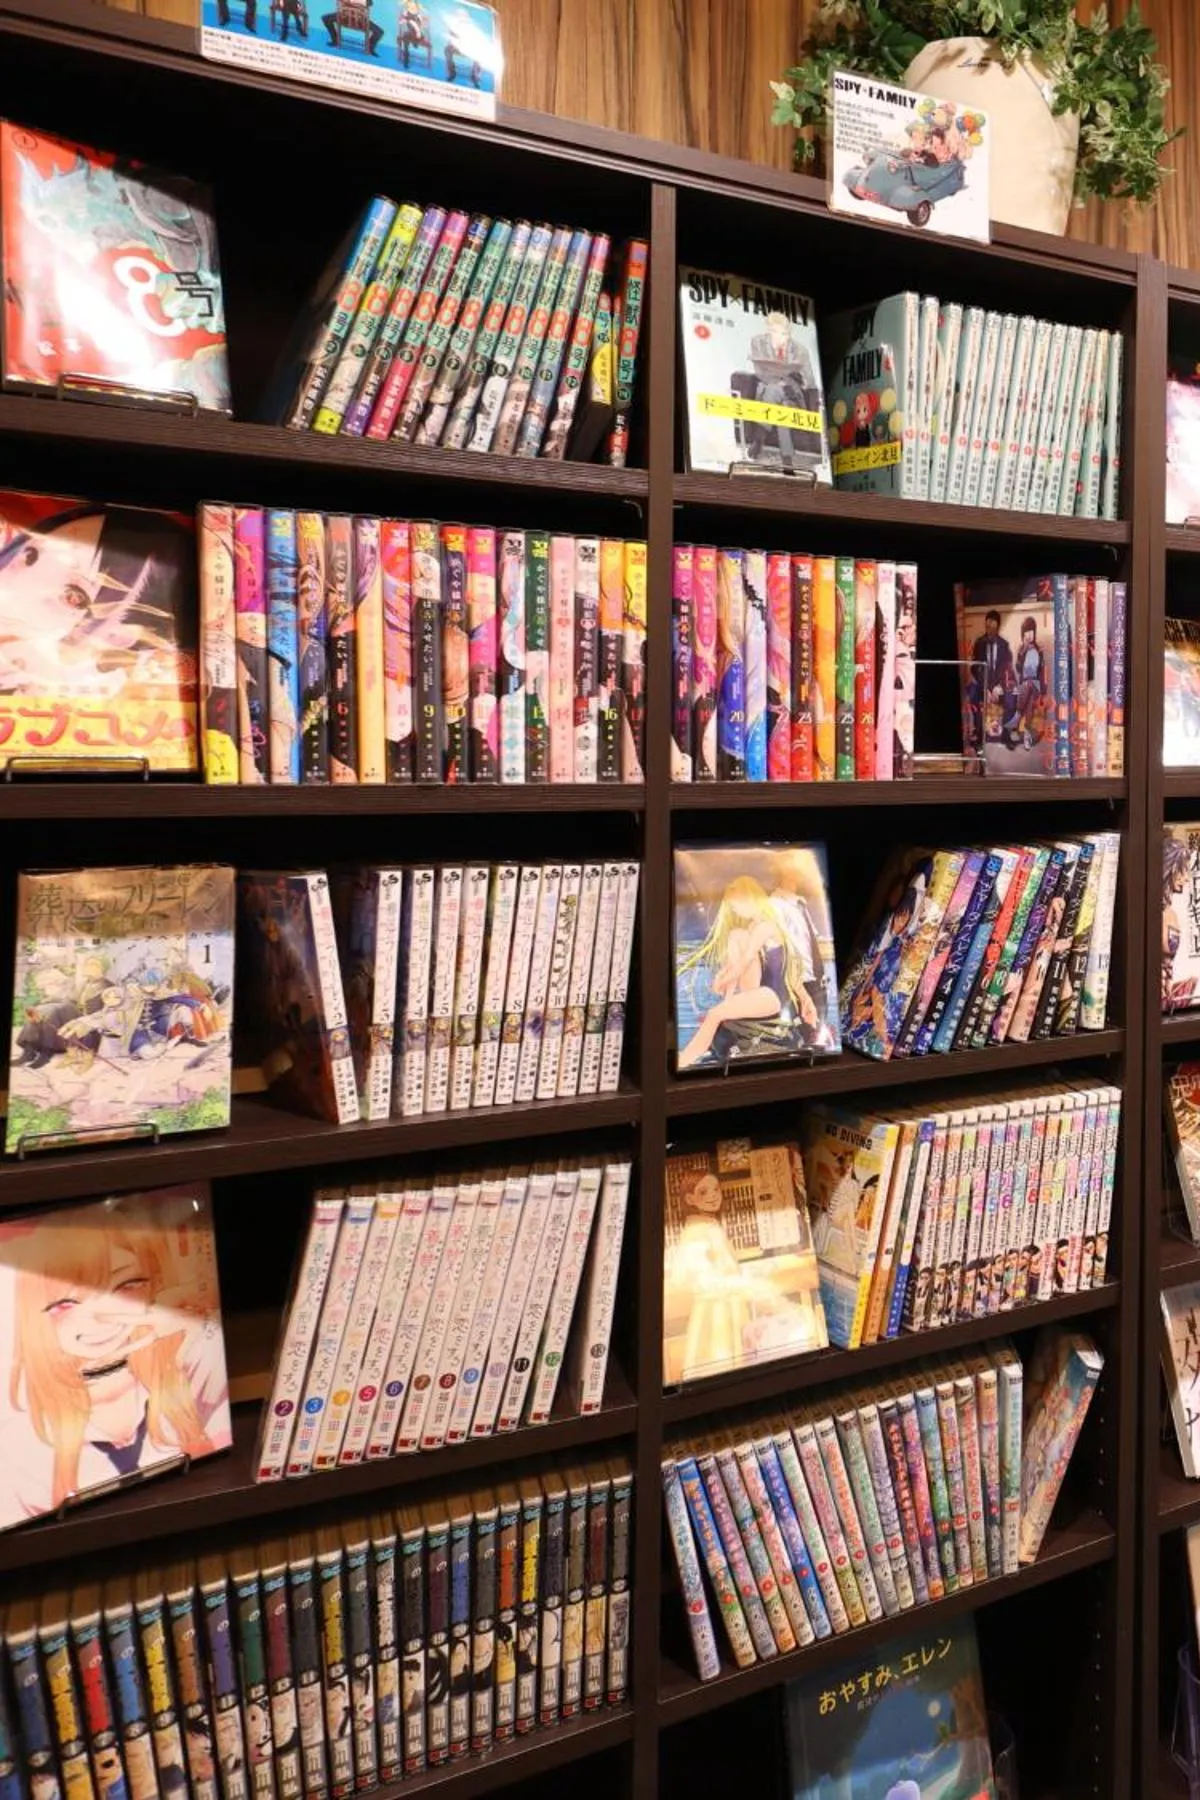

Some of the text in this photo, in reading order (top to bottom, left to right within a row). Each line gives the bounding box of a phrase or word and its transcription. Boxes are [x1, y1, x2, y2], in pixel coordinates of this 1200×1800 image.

[203, 944, 211, 964] 1
[818, 1638, 952, 1716] おやすみ、エレン
